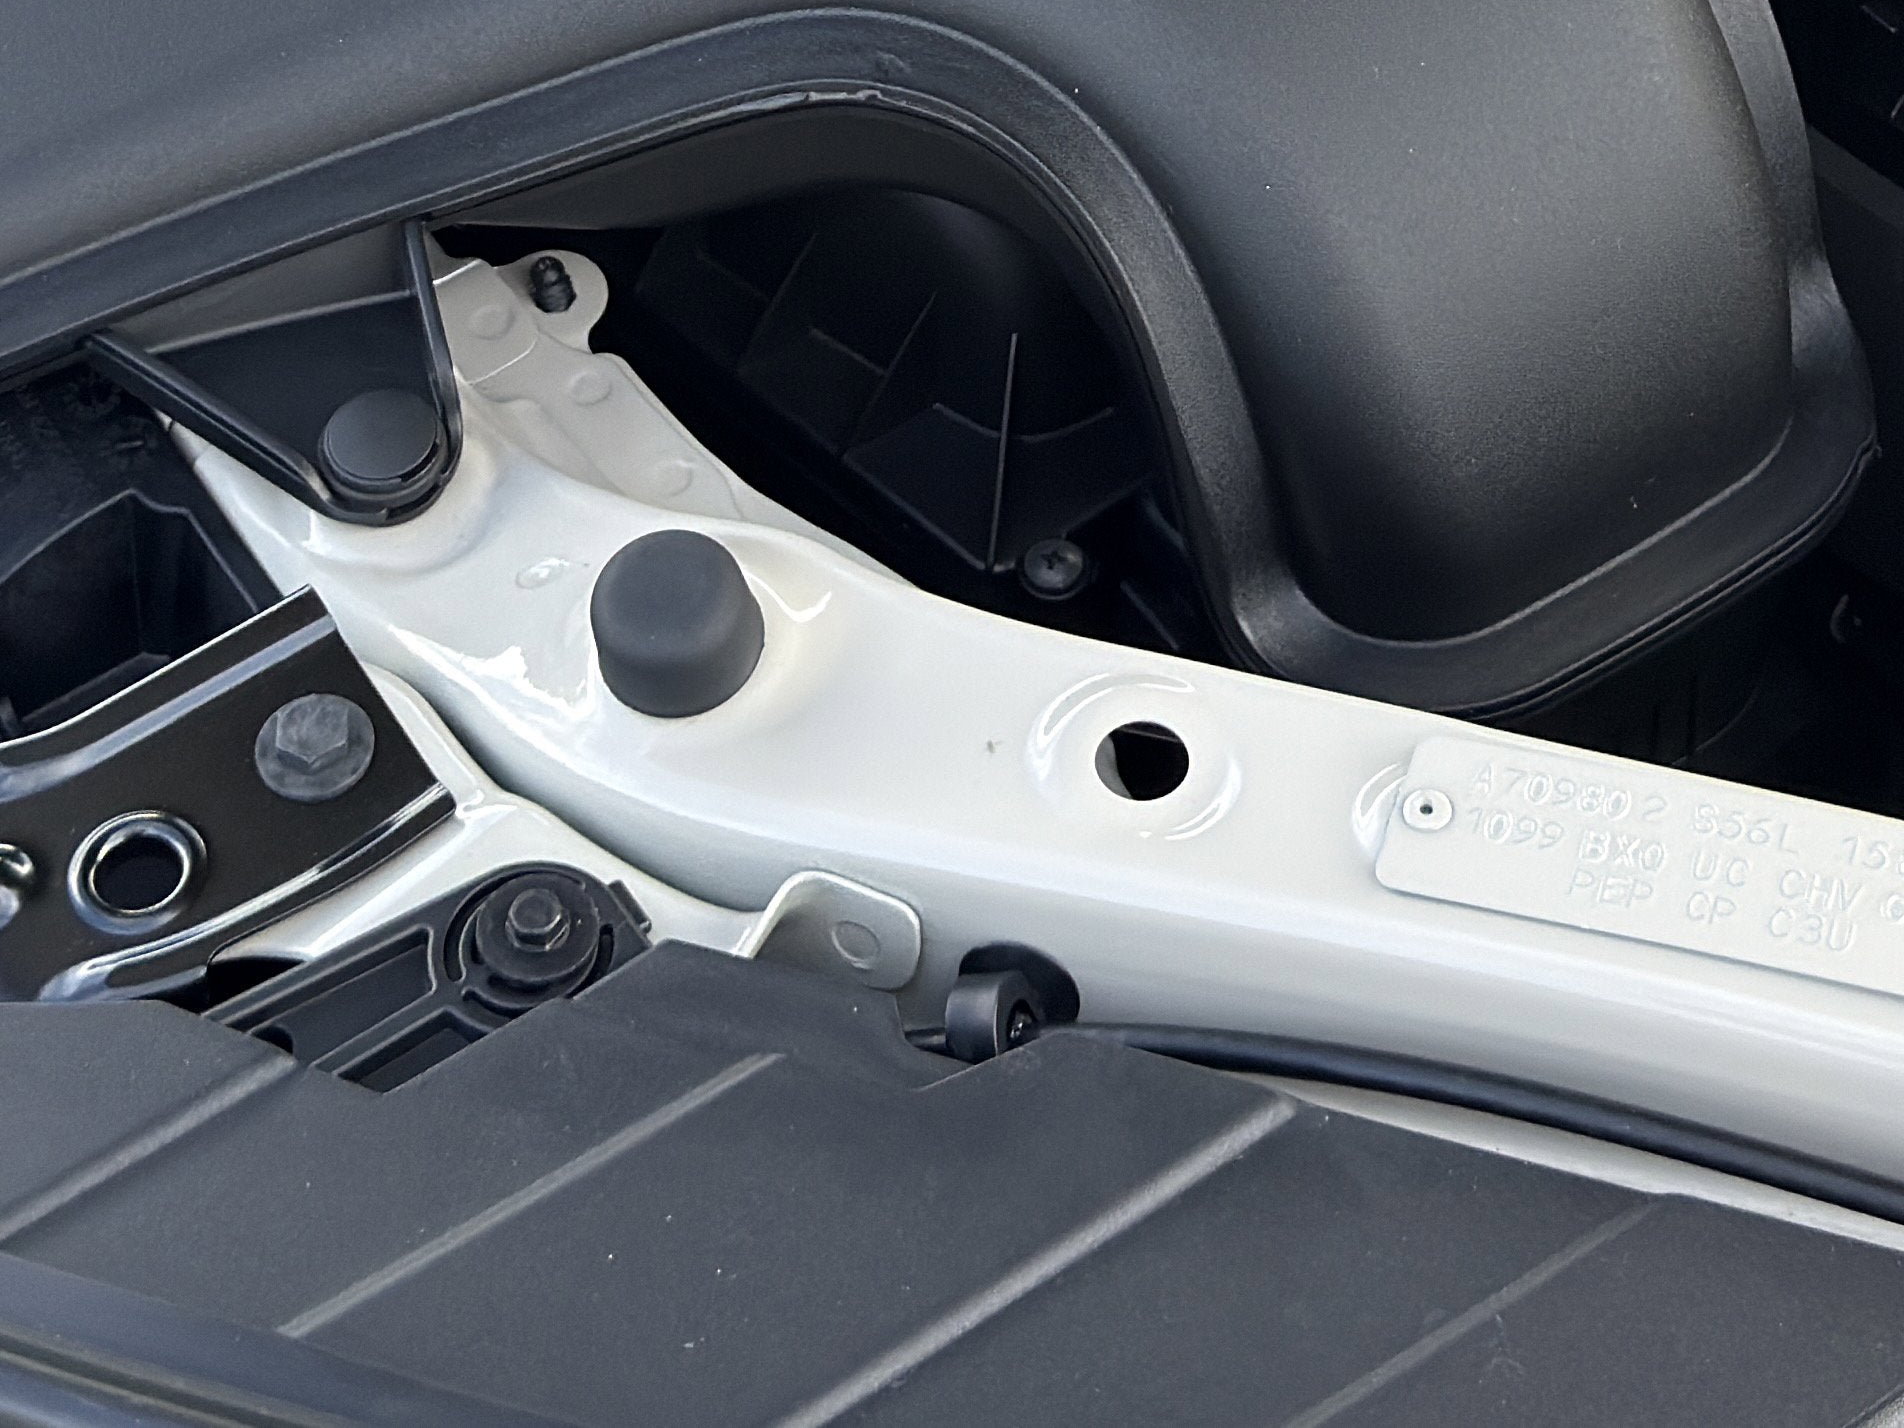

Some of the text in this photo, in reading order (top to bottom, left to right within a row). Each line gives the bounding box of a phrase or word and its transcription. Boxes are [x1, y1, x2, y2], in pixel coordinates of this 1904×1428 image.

[1469, 806, 1565, 849] 1099
[1691, 851, 1752, 889] UC
[1778, 869, 1864, 912] CHV
[1569, 868, 1858, 952] PEP CP C3U
